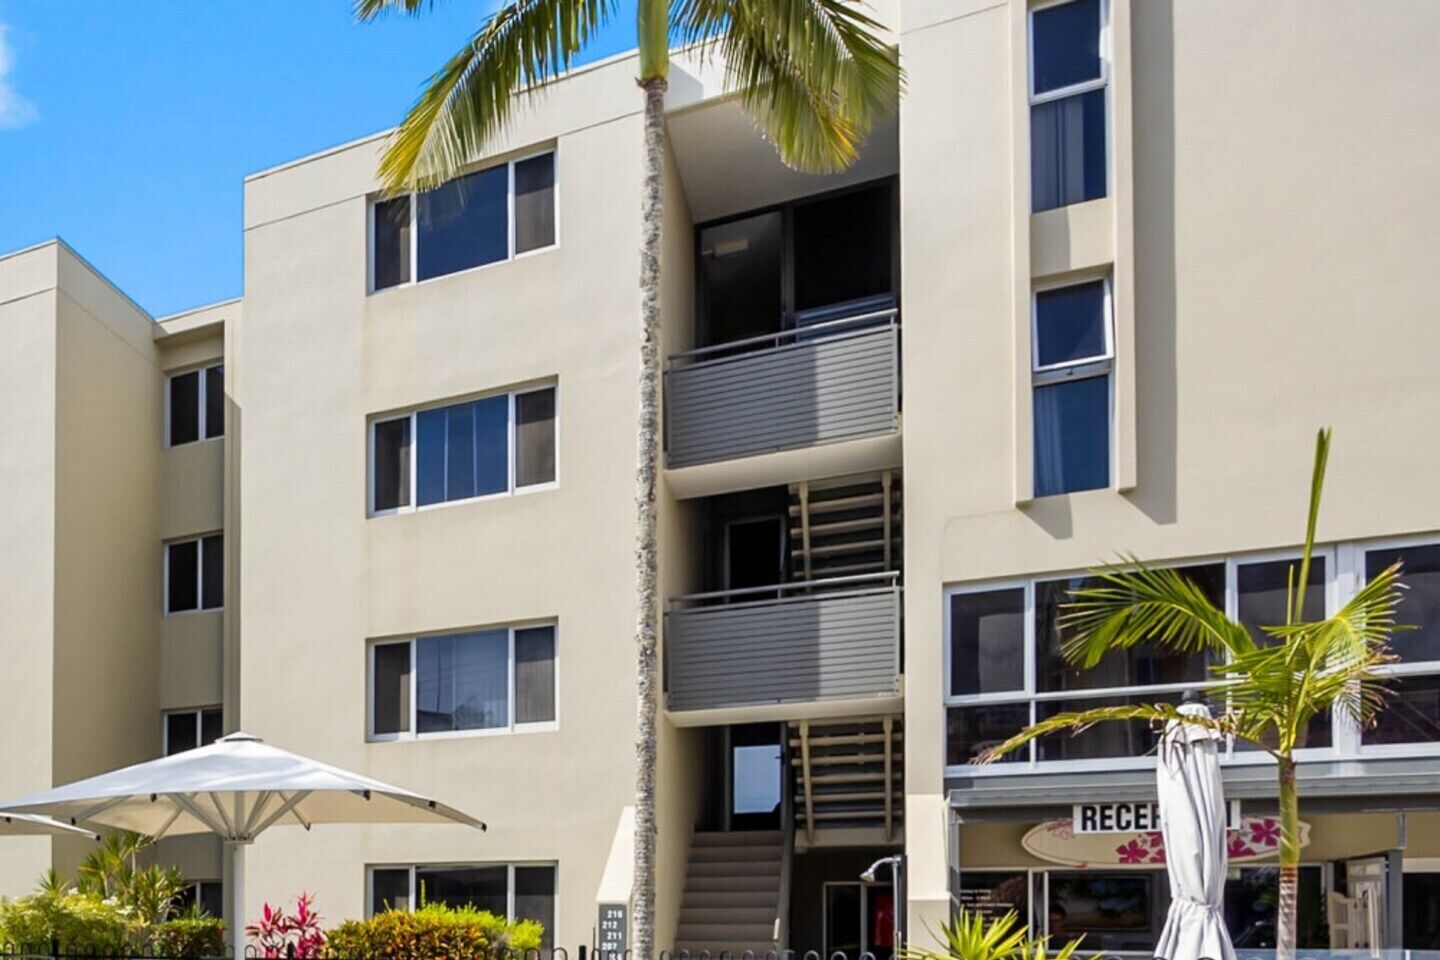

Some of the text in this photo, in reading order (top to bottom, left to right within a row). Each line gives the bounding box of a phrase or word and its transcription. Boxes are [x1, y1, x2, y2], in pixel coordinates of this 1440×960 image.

[602, 921, 617, 929] 212
[607, 932, 622, 940] 211
[601, 943, 617, 951] 207
